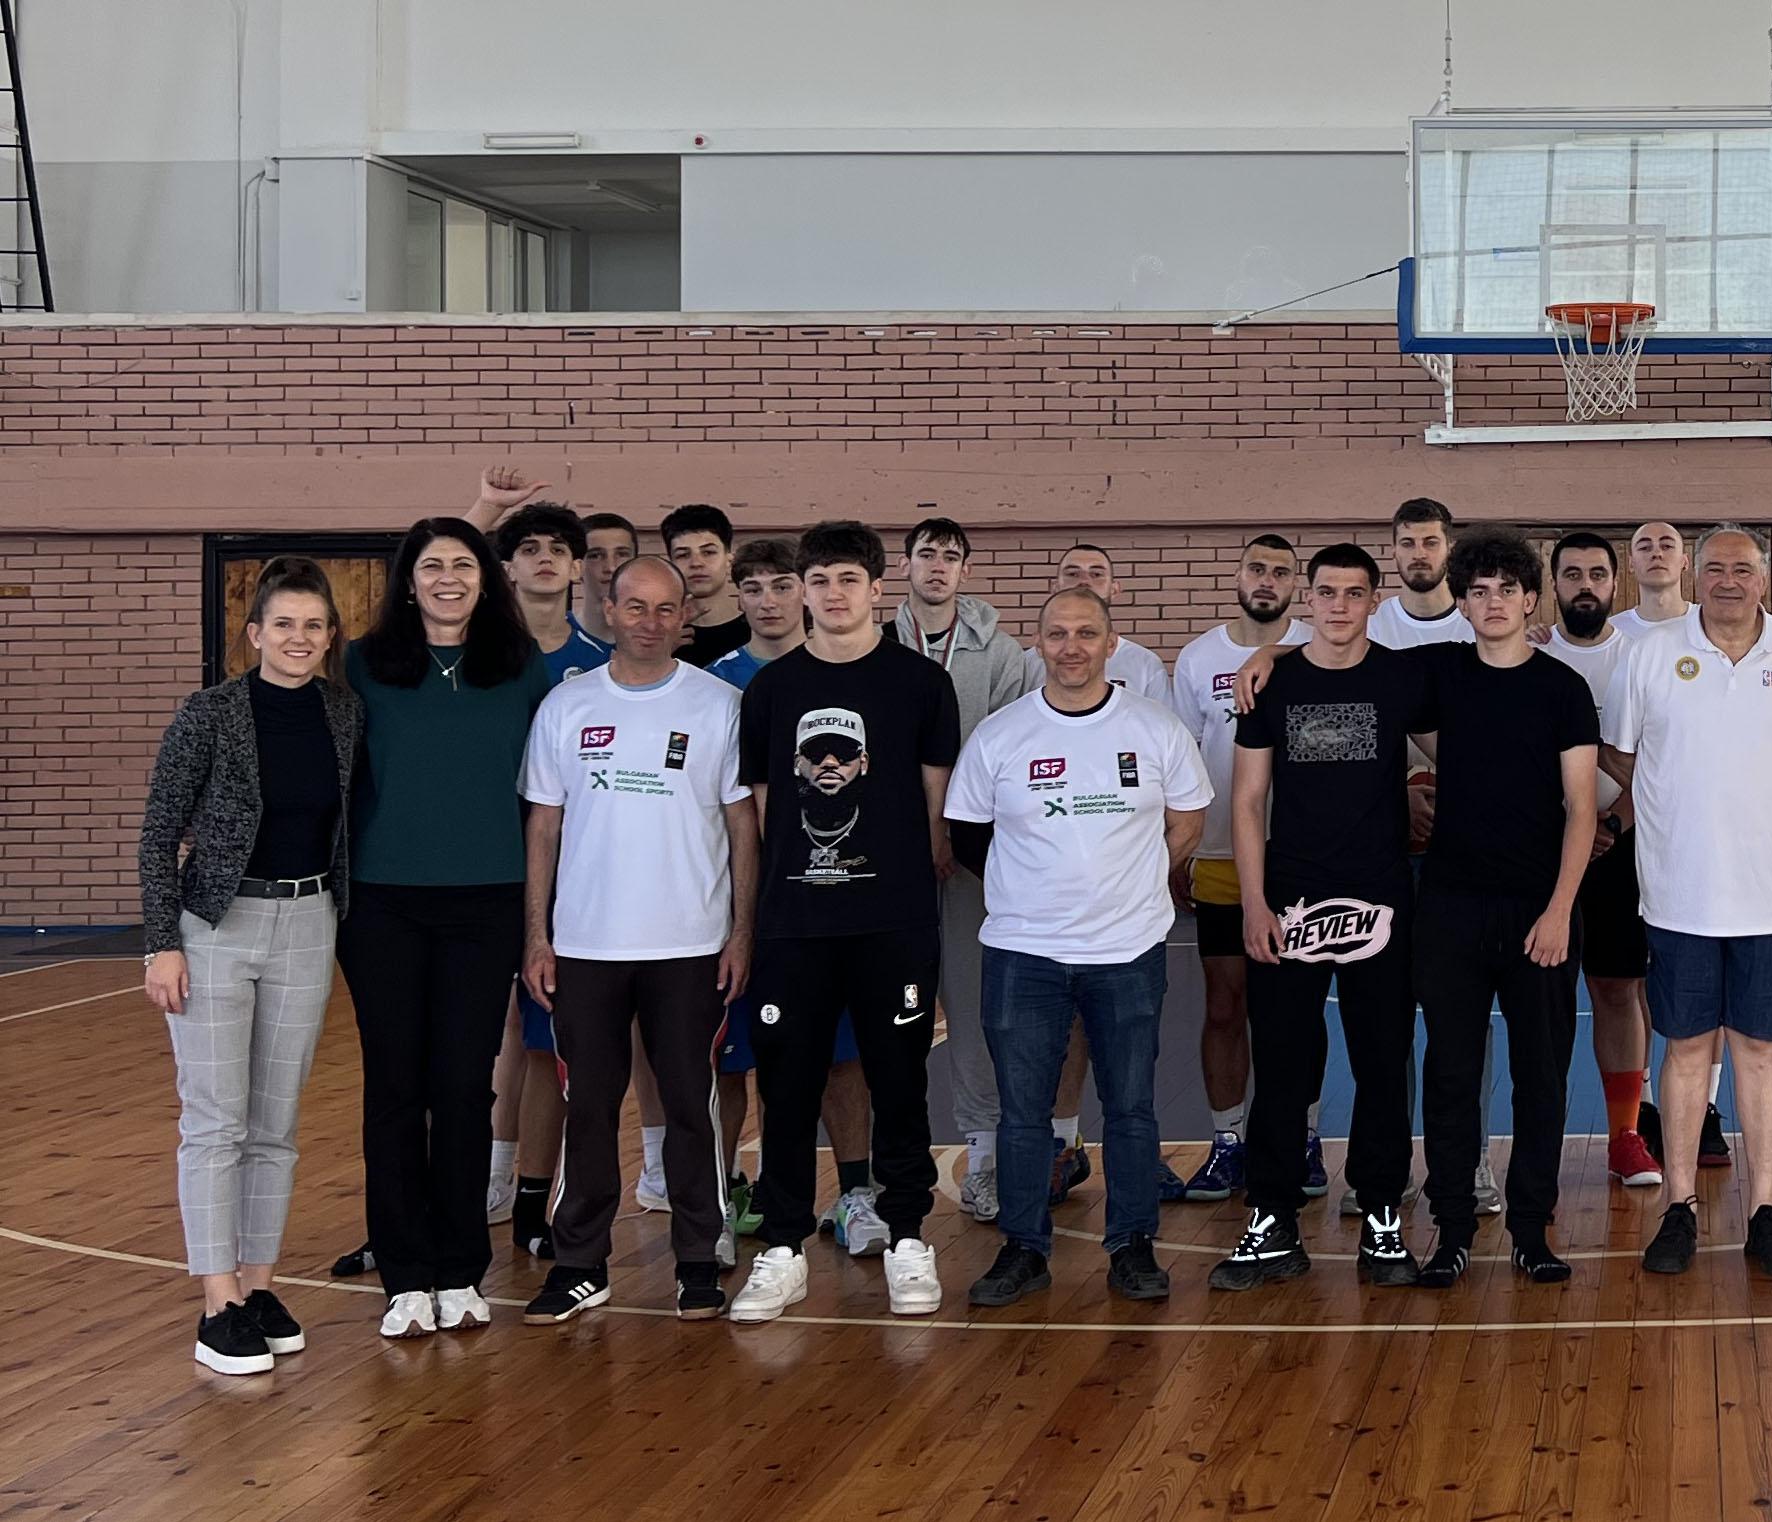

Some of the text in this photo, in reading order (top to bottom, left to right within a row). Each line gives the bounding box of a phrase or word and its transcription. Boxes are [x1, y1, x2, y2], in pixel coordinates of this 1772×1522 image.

[584, 730, 612, 744] ISF
[1033, 761, 1062, 776] ISF
[1283, 909, 1381, 952] REVIEW
